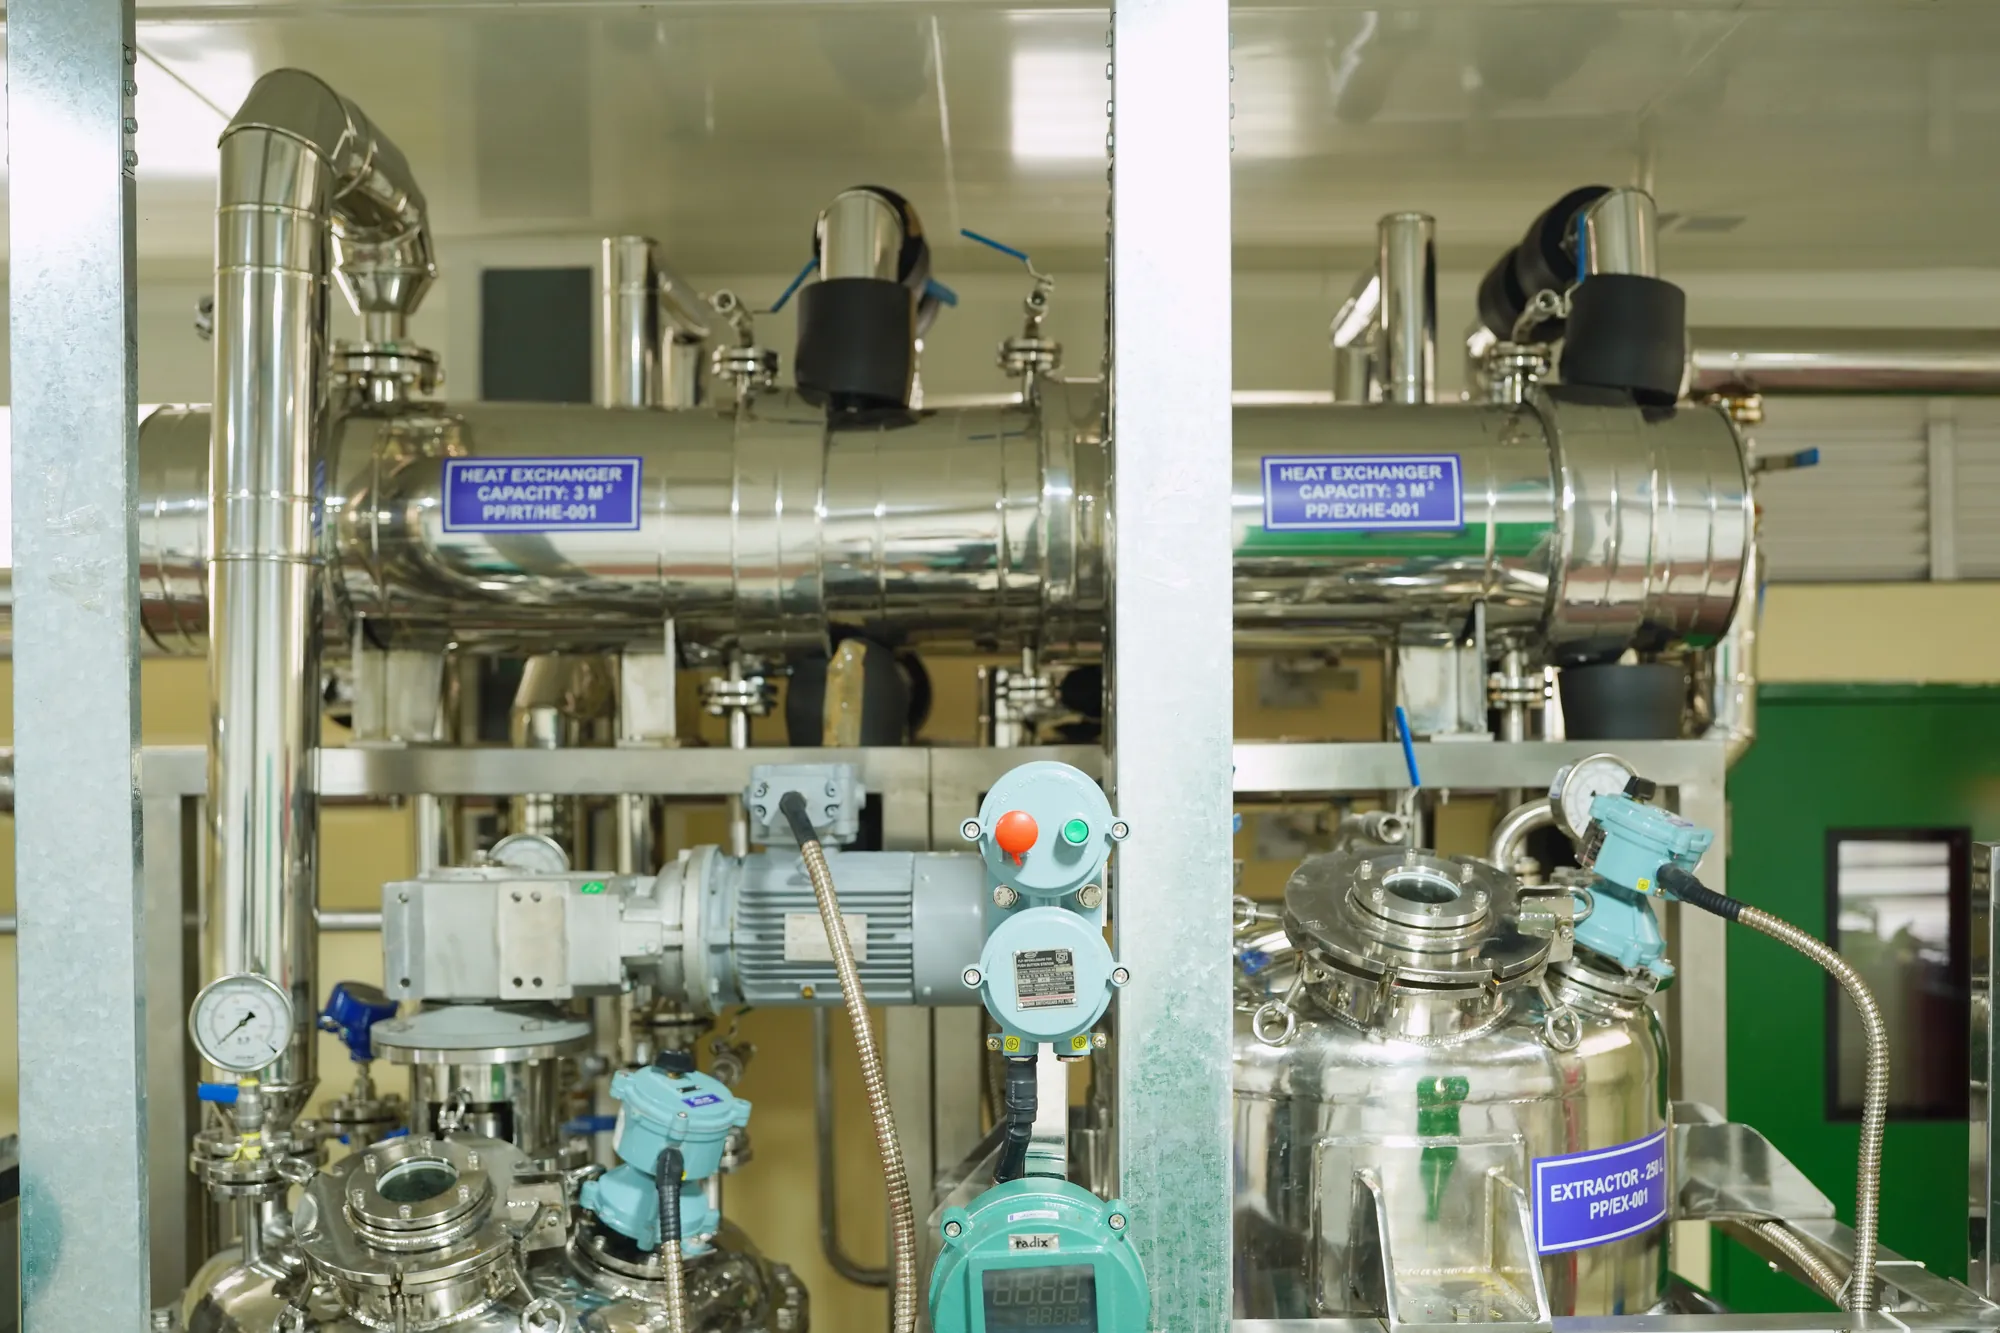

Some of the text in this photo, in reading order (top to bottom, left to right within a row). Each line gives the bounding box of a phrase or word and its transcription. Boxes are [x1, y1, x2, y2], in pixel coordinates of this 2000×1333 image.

[460, 467, 622, 483] HEAT EXCHANGER
[1280, 465, 1442, 481] HEAT EXCHANGER
[477, 485, 569, 501] CAPACITY:
[573, 485, 584, 500] 3
[1299, 483, 1391, 499] CAPACITY:
[1396, 483, 1406, 498] 3
[482, 504, 597, 520] PP/RT/HE-001
[1305, 502, 1420, 519] PP/EX/HE-001
[1550, 1168, 1639, 1202] EXTRACTOR
[1590, 1187, 1648, 1220] PP/EX-001
[1015, 1235, 1049, 1249] radix
